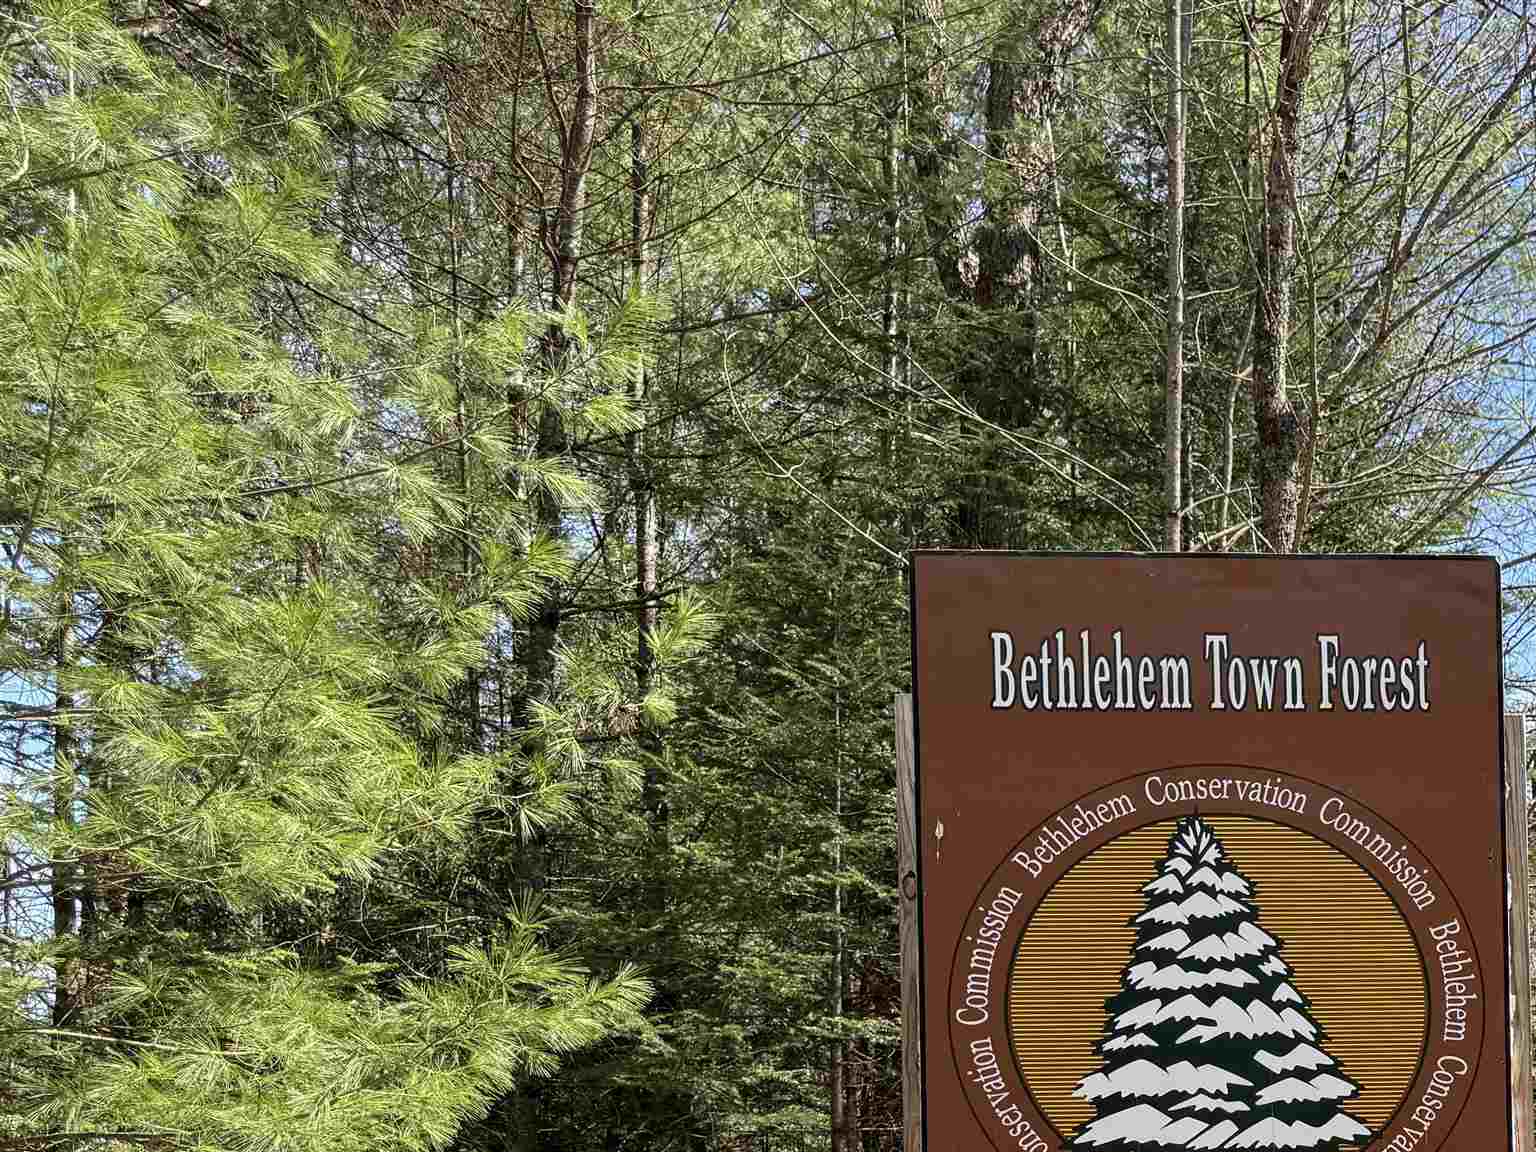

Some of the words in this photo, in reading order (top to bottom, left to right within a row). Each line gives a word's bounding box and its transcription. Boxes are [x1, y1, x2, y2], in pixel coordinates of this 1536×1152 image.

[991, 629, 1192, 710] Bethlehem
[1204, 634, 1305, 710] Town
[1317, 635, 1429, 711] Forest
[1012, 790, 1137, 879] Bethlehem
[1143, 774, 1309, 814] Conservation
[1317, 797, 1437, 913] Commission
[955, 886, 1023, 1027] Commission
[1428, 917, 1478, 1044] Bethlehem
